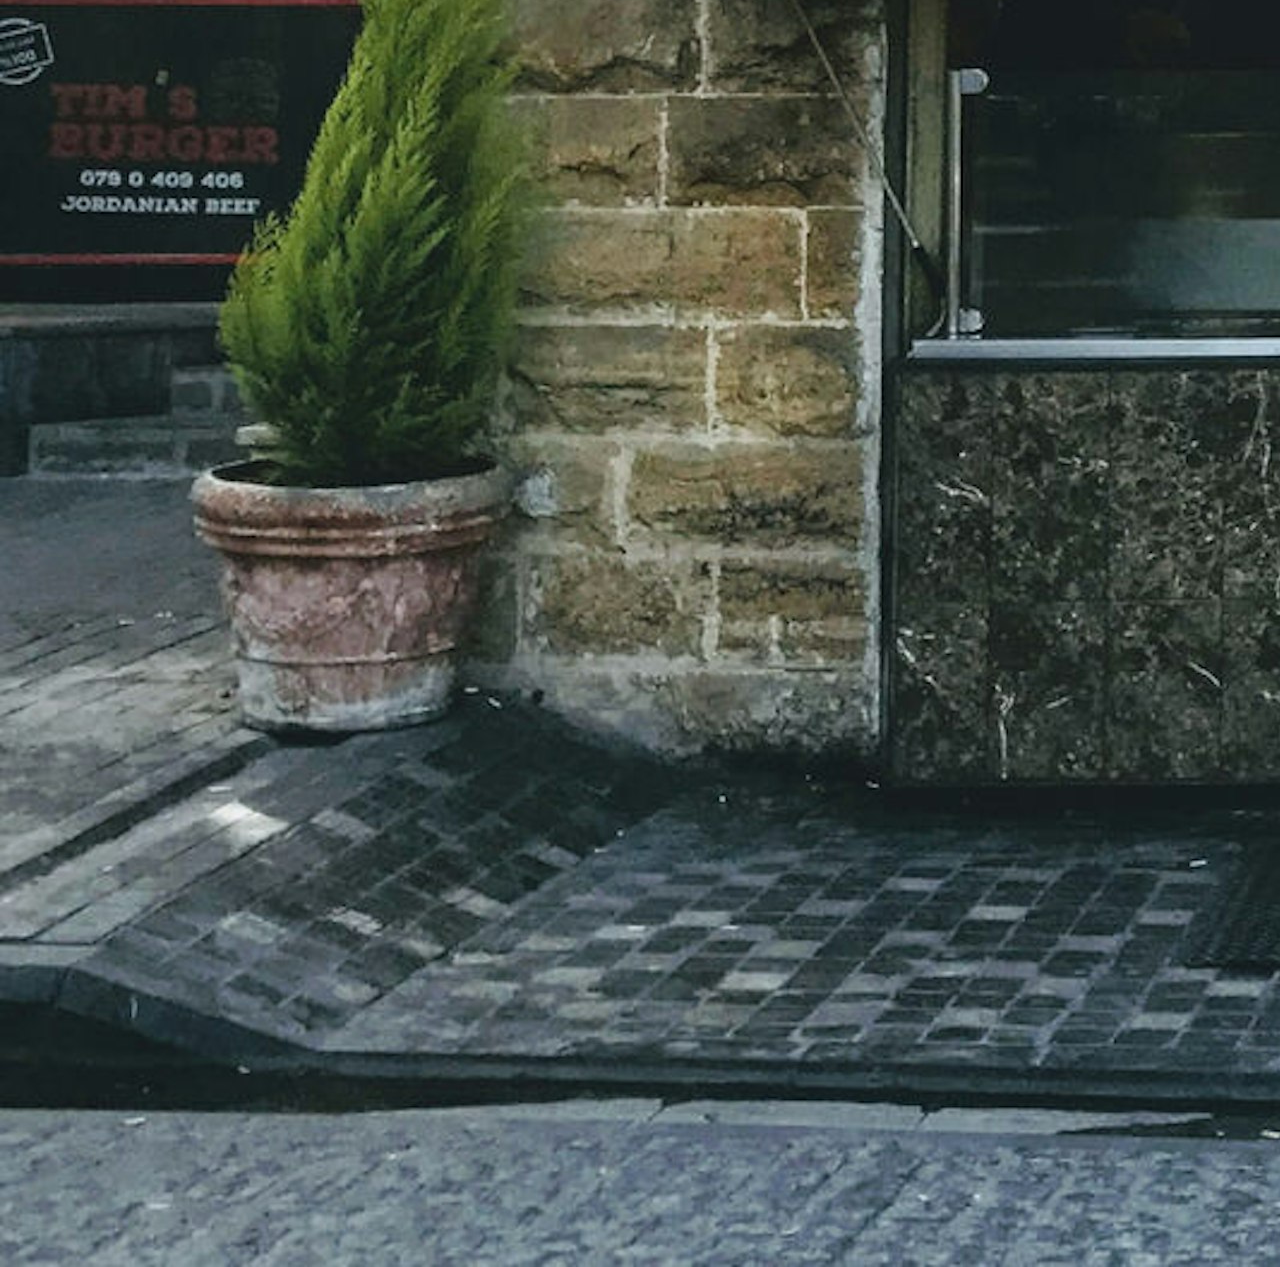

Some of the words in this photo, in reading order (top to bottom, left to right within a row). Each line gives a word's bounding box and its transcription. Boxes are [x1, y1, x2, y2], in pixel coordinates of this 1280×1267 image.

[48, 122, 280, 165] BURGER
[127, 170, 144, 187] 0
[60, 196, 198, 212] JORDANIAN
[204, 197, 261, 214] BEEF
